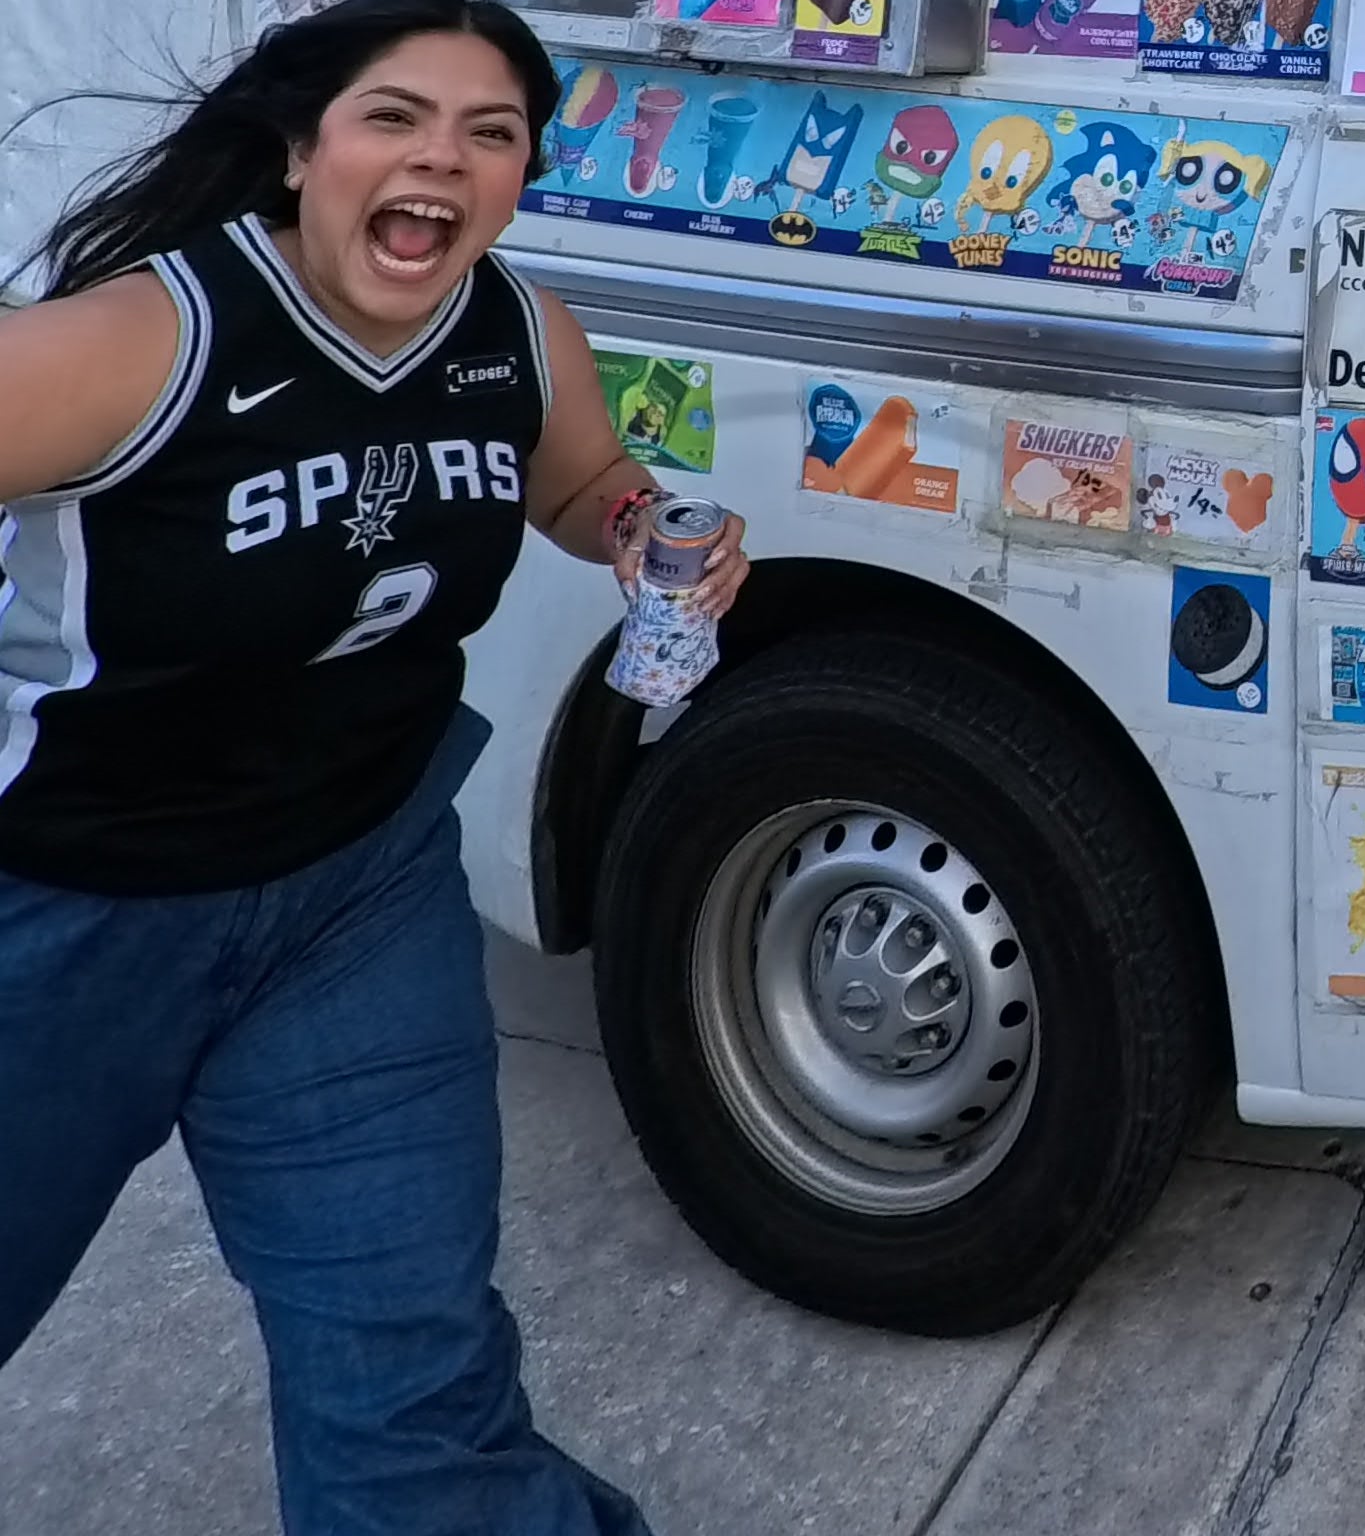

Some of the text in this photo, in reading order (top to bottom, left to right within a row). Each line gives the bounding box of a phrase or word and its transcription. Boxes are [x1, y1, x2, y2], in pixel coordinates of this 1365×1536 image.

[1209, 52, 1268, 63] CHOCOLATE
[1280, 56, 1322, 66] VANILLA
[1280, 65, 1321, 75] CRUNCH
[623, 209, 655, 221] CHERRY
[857, 228, 923, 260] TURTLES
[948, 233, 1011, 254] LOONEY
[955, 250, 1005, 267] TUNES
[1053, 246, 1122, 270] SONIC
[1154, 258, 1235, 286] POWERPUFF
[457, 364, 512, 385] LEDGER
[1019, 423, 1121, 461] SNICKERS
[913, 477, 950, 490] ORANGE
[1168, 468, 1217, 487] MOUSE
[224, 439, 521, 558] SPURS
[304, 562, 439, 667] 2
